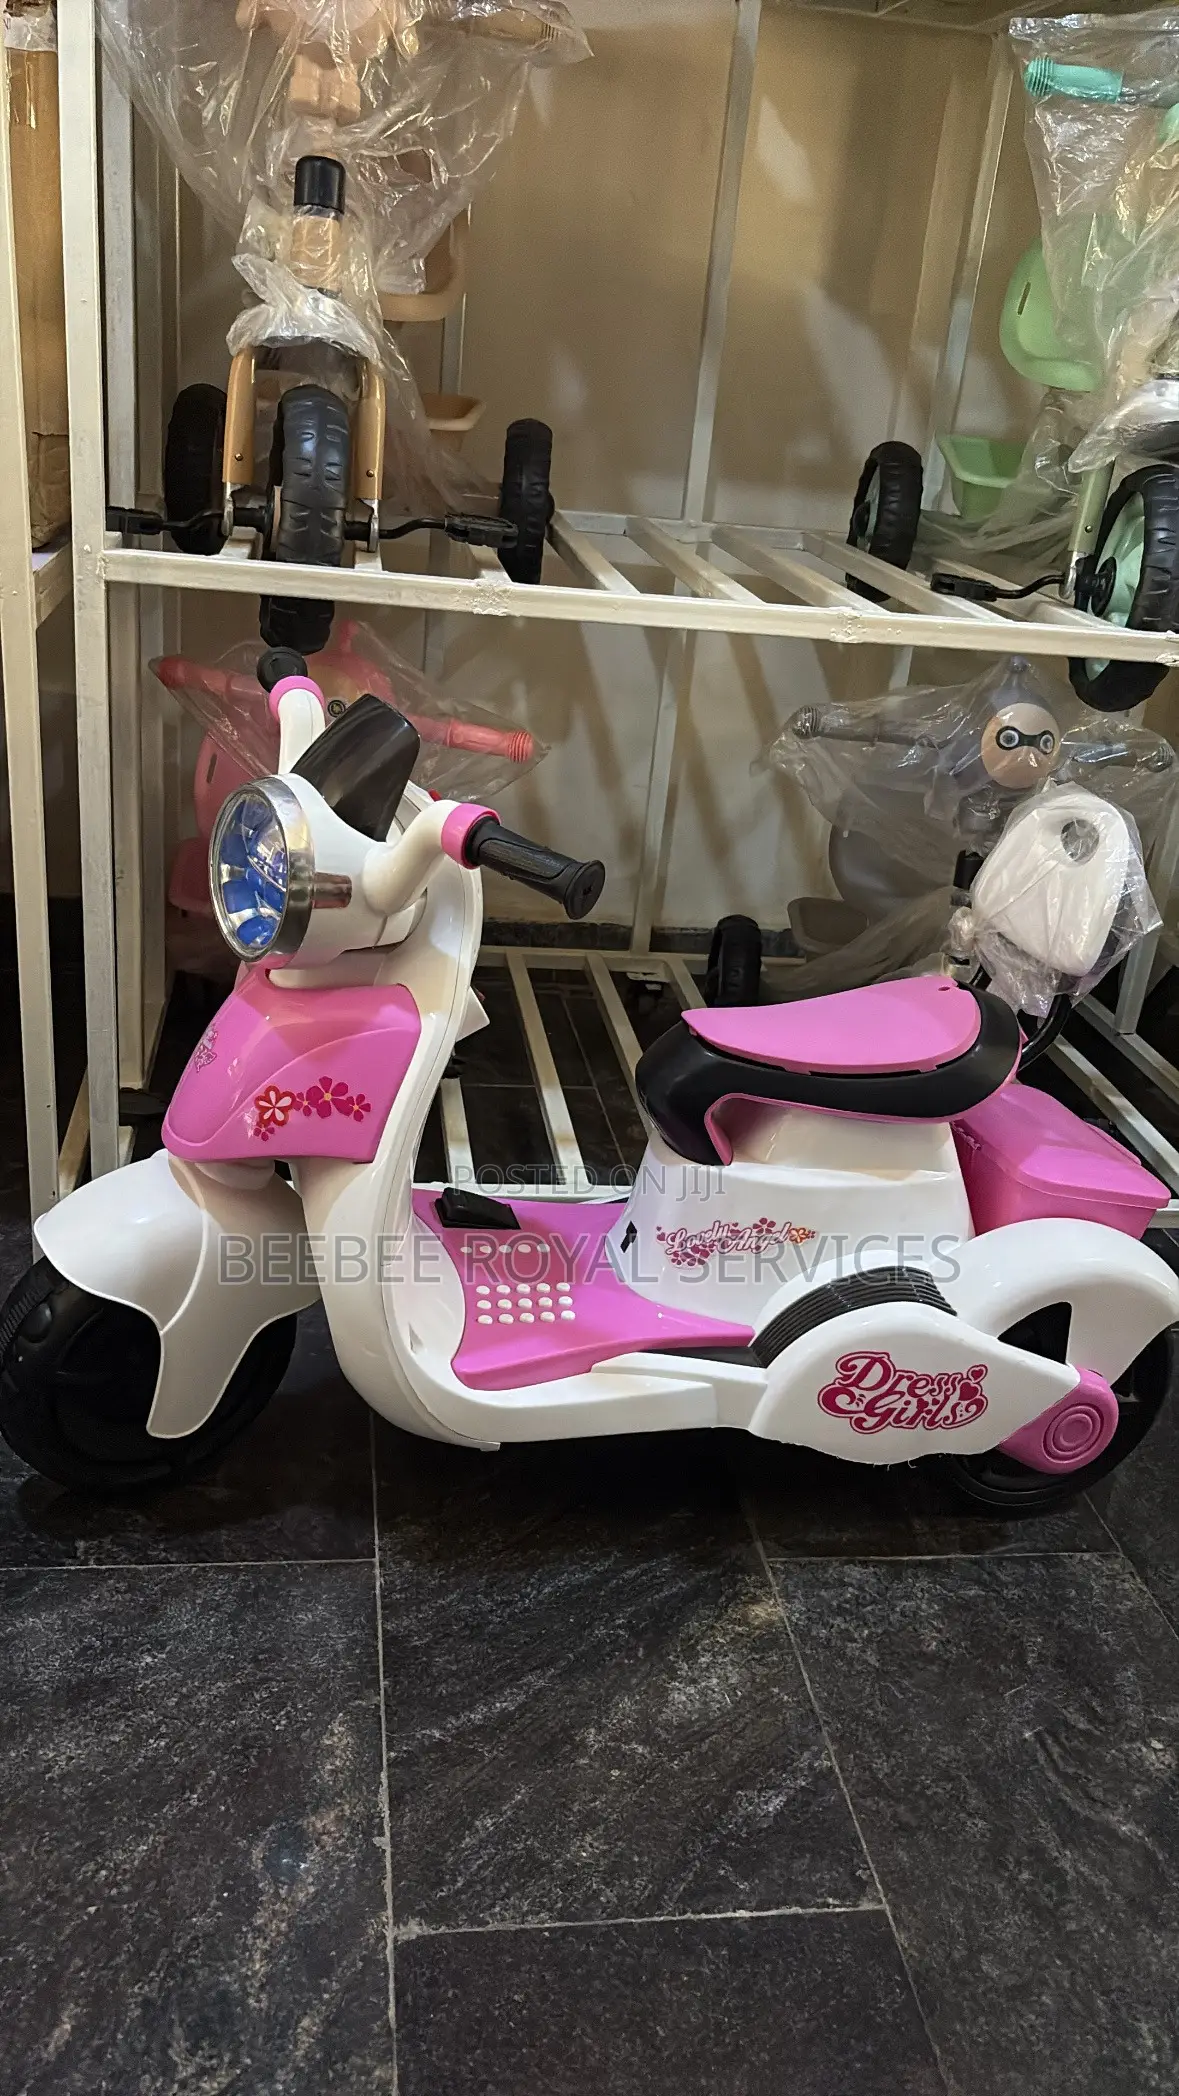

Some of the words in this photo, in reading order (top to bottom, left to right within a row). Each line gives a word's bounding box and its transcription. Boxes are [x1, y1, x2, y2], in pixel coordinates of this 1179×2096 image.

[665, 1220, 731, 1255] Lovely
[717, 1222, 792, 1254] Angel
[835, 1351, 965, 1398] Dress
[818, 1385, 988, 1434] Girls
